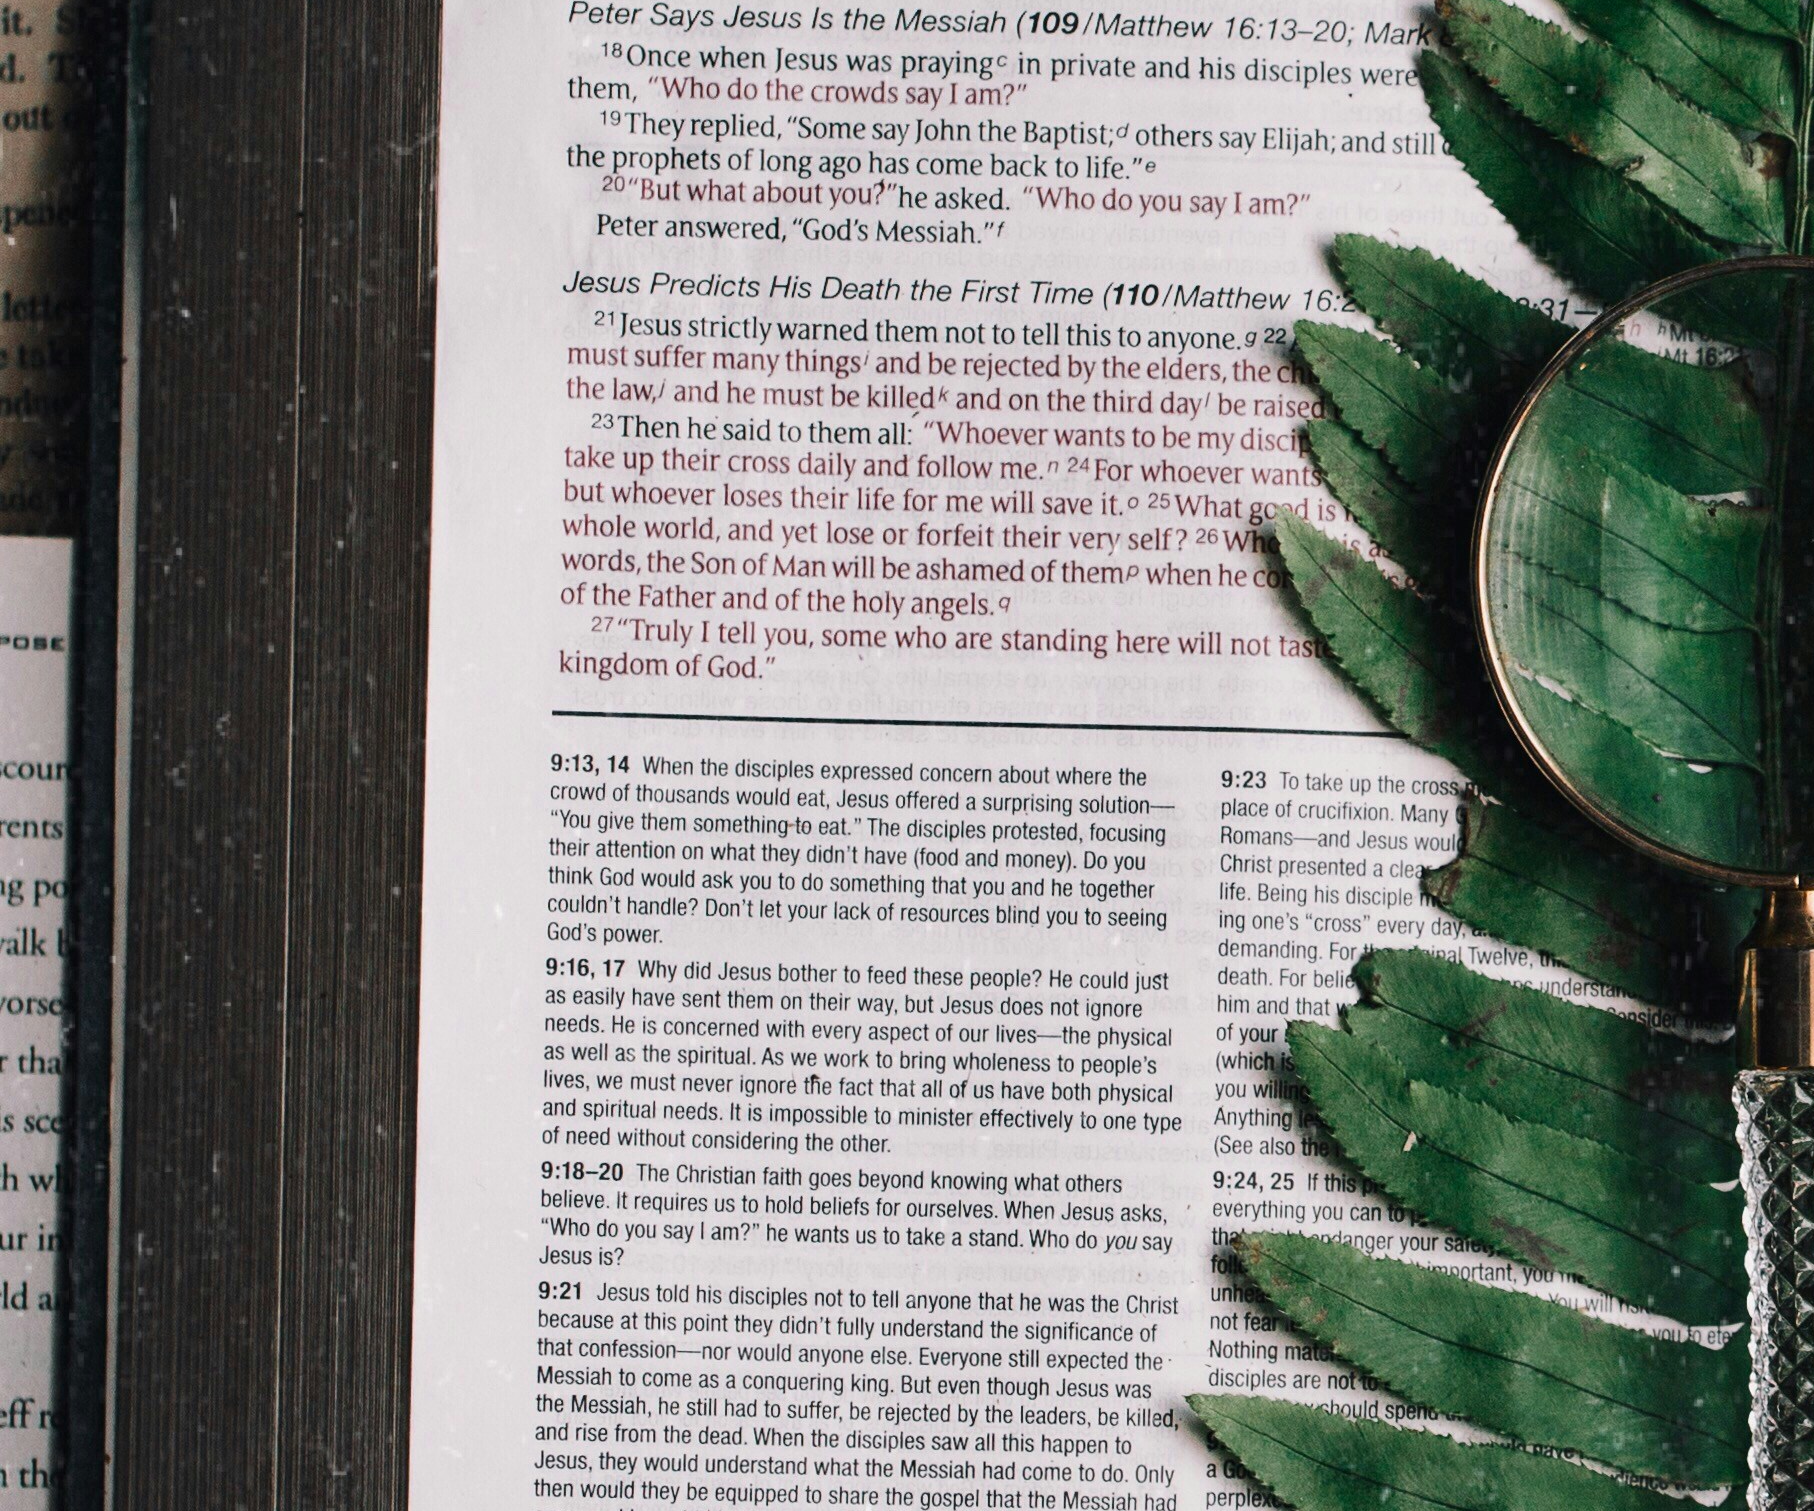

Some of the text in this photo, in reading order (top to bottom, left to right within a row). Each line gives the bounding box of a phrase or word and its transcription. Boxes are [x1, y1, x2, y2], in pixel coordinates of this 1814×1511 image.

[569, 1, 642, 24] Peter
[650, 2, 714, 32] Says
[723, 5, 801, 29] Jesus
[812, 7, 833, 29] Is
[844, 8, 885, 31] the
[895, 9, 1006, 33] Messiah
[1364, 20, 1431, 47] Mark
[551, 754, 1146, 786] 9:13, 14 When the disciples expressed concern about where the
[547, 922, 662, 945] God's power.
